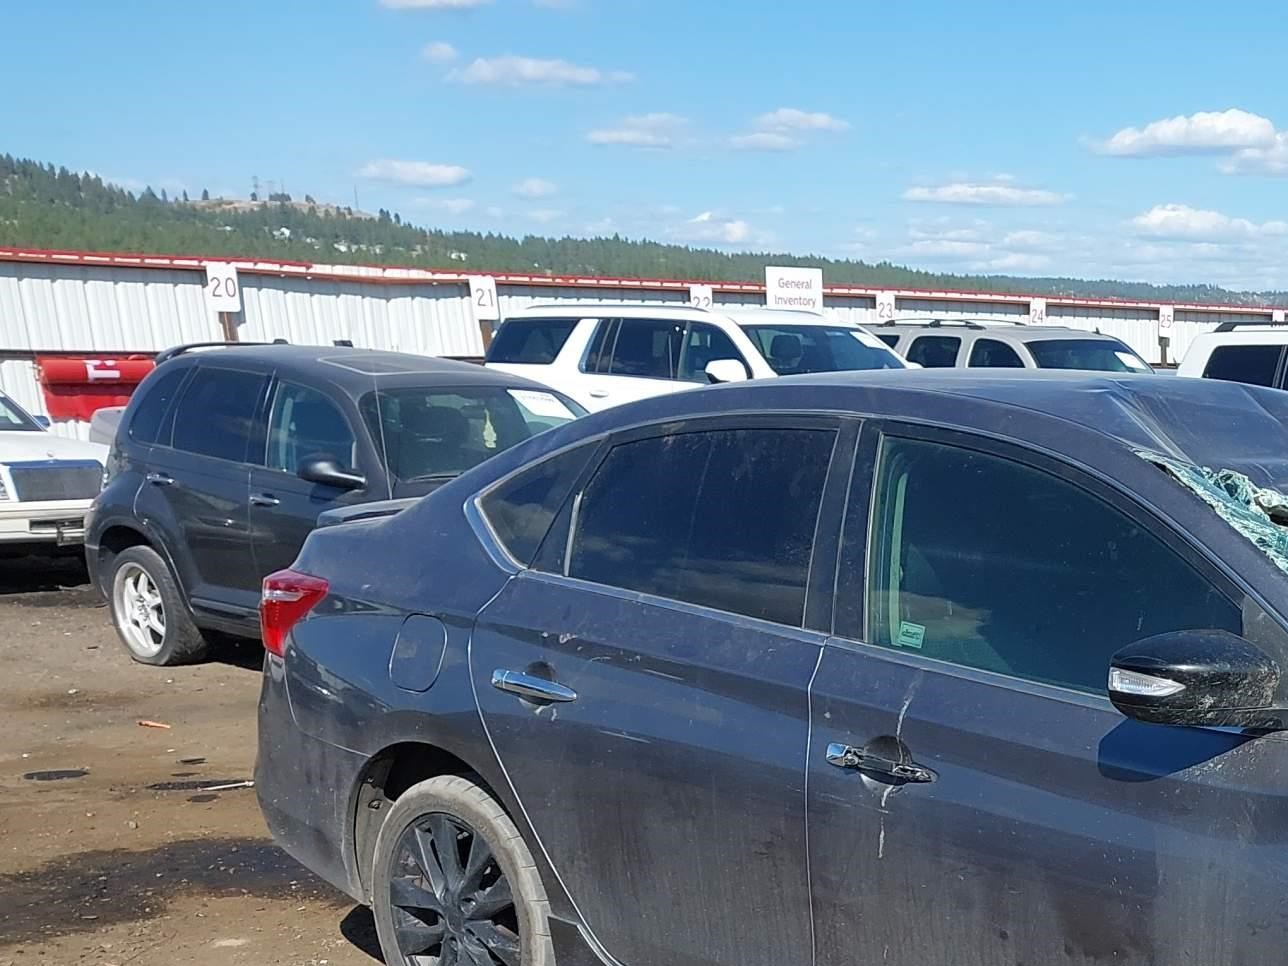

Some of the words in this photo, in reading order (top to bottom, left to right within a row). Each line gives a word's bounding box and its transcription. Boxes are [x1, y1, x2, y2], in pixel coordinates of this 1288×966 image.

[210, 276, 237, 298] 20
[777, 277, 813, 290] General
[475, 287, 494, 307] 21
[774, 294, 817, 309] Inventory
[878, 302, 893, 319] 23
[1031, 309, 1044, 324] 24
[1160, 314, 1172, 329] 25
